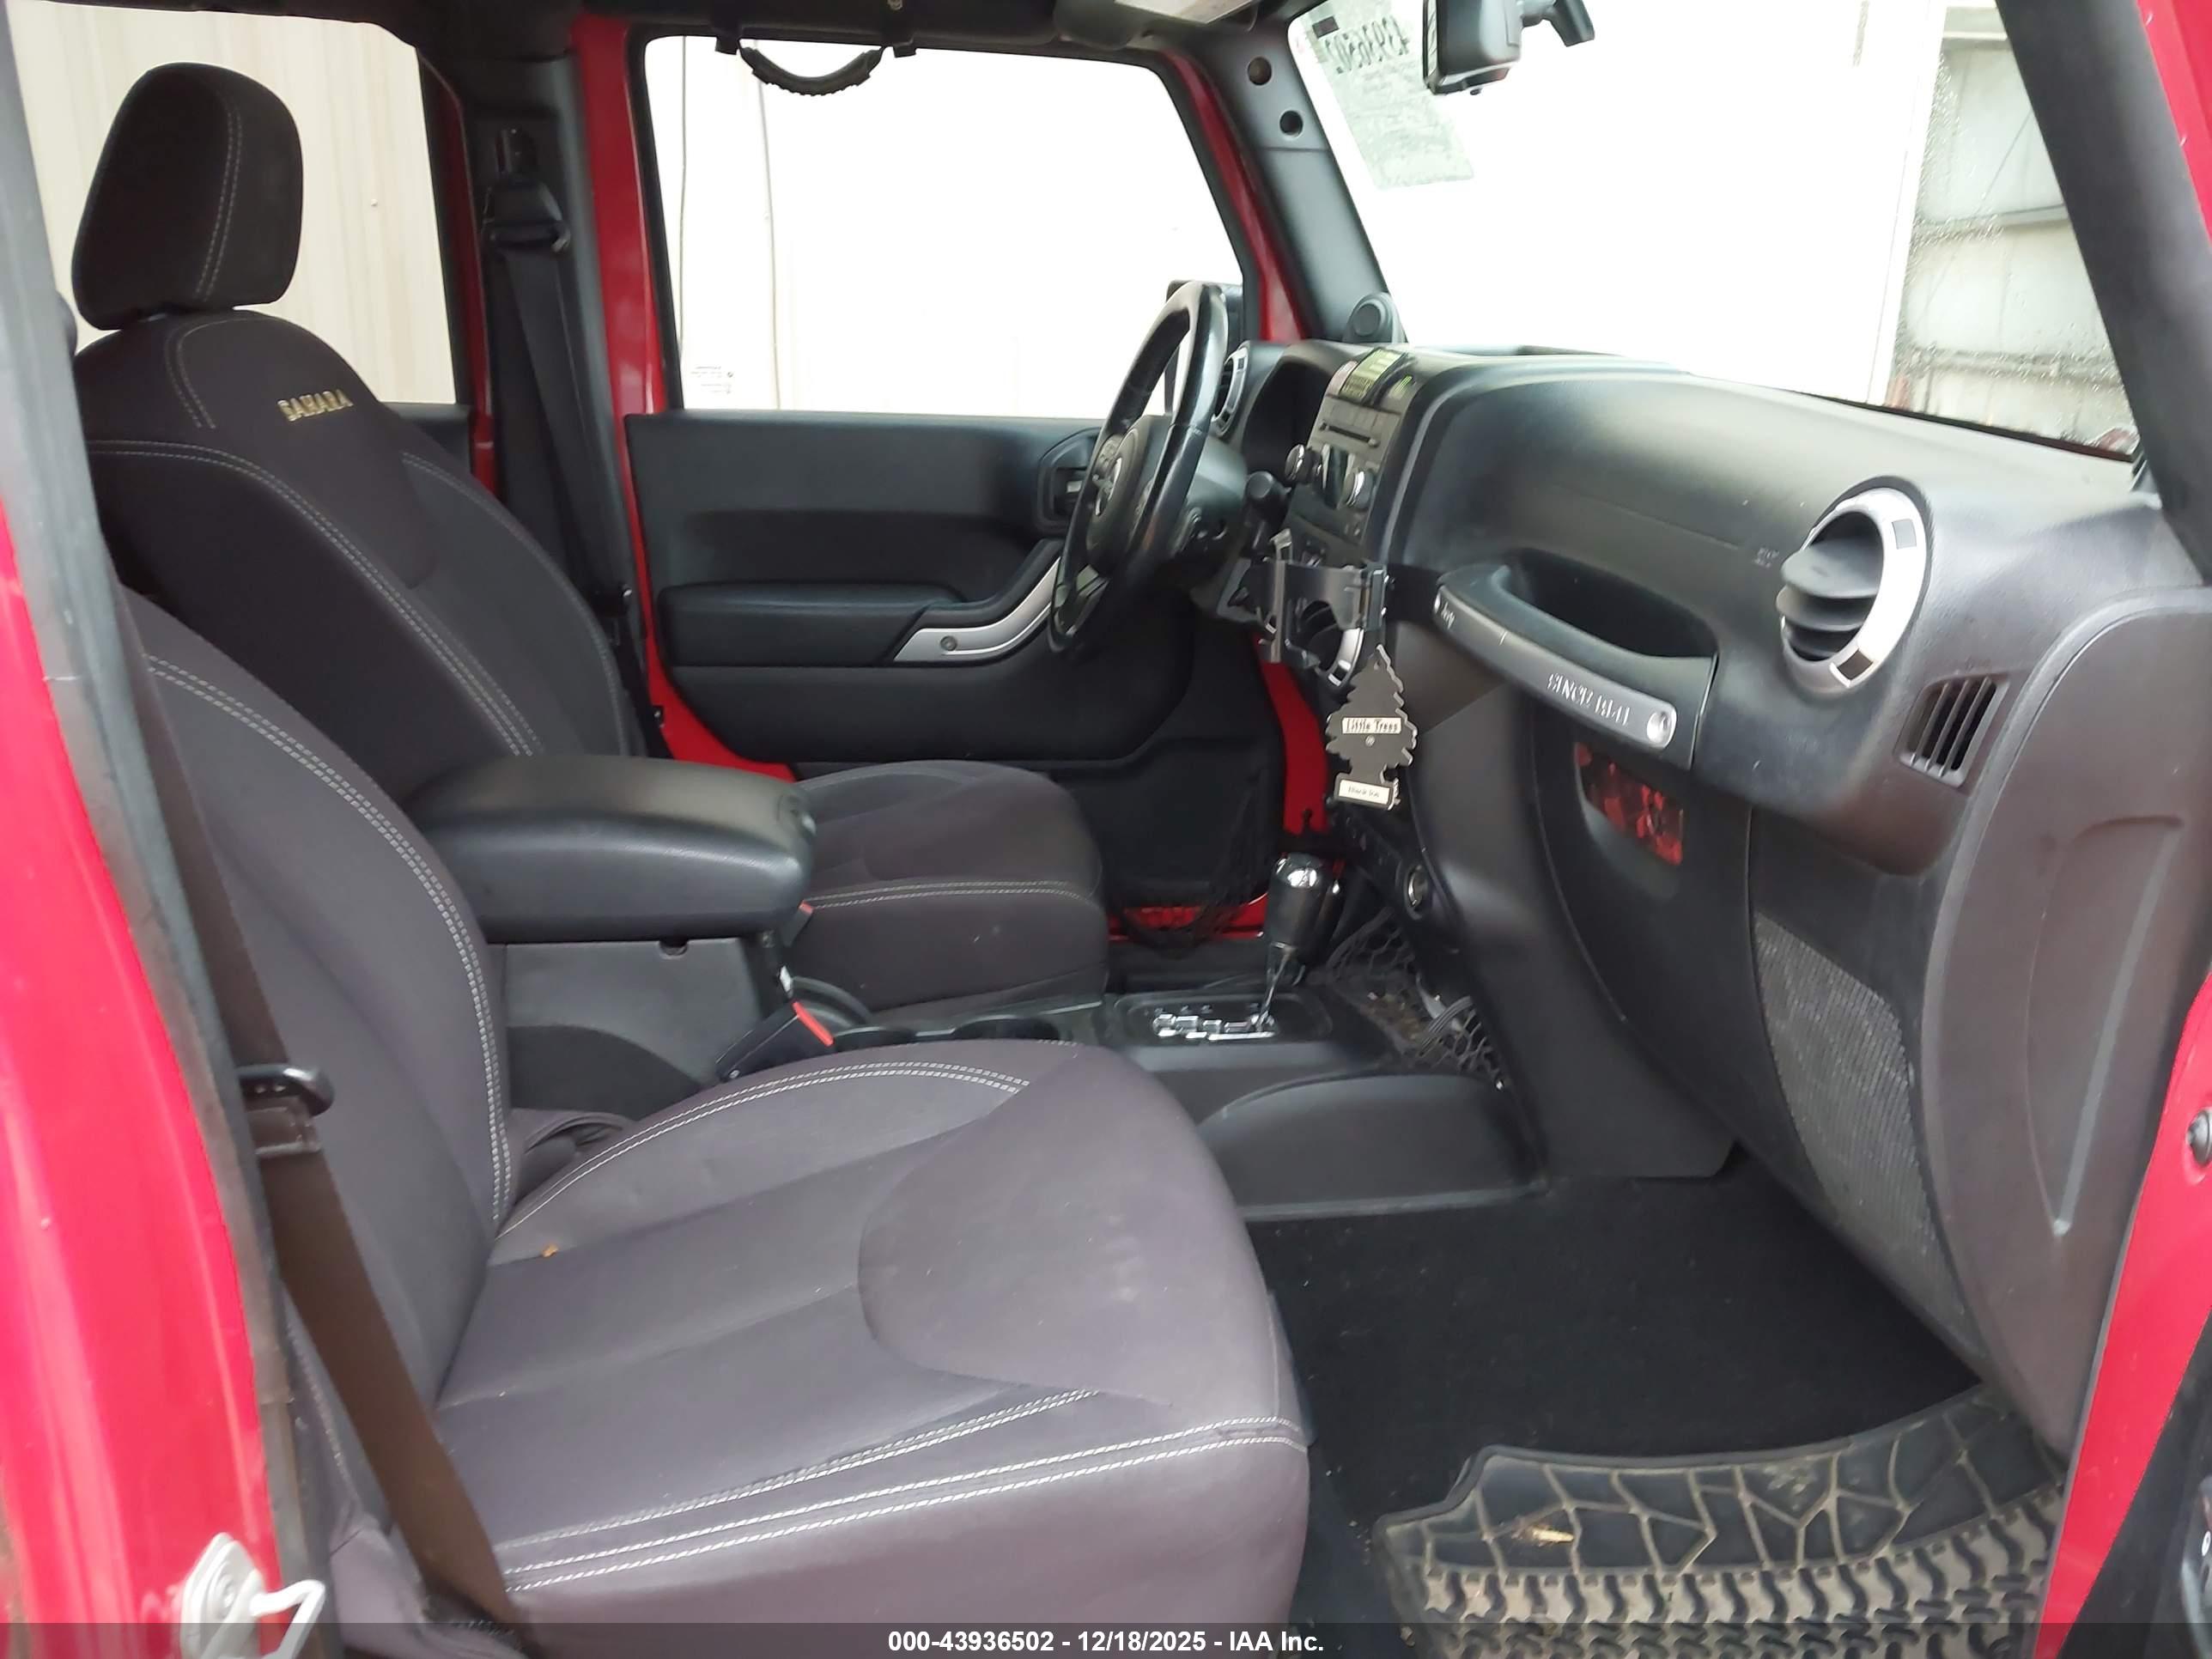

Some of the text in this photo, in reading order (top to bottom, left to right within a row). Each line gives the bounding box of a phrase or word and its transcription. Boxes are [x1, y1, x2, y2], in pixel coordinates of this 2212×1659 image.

[276, 389, 354, 422] SAHARA
[1346, 718, 1398, 733] Little Trees
